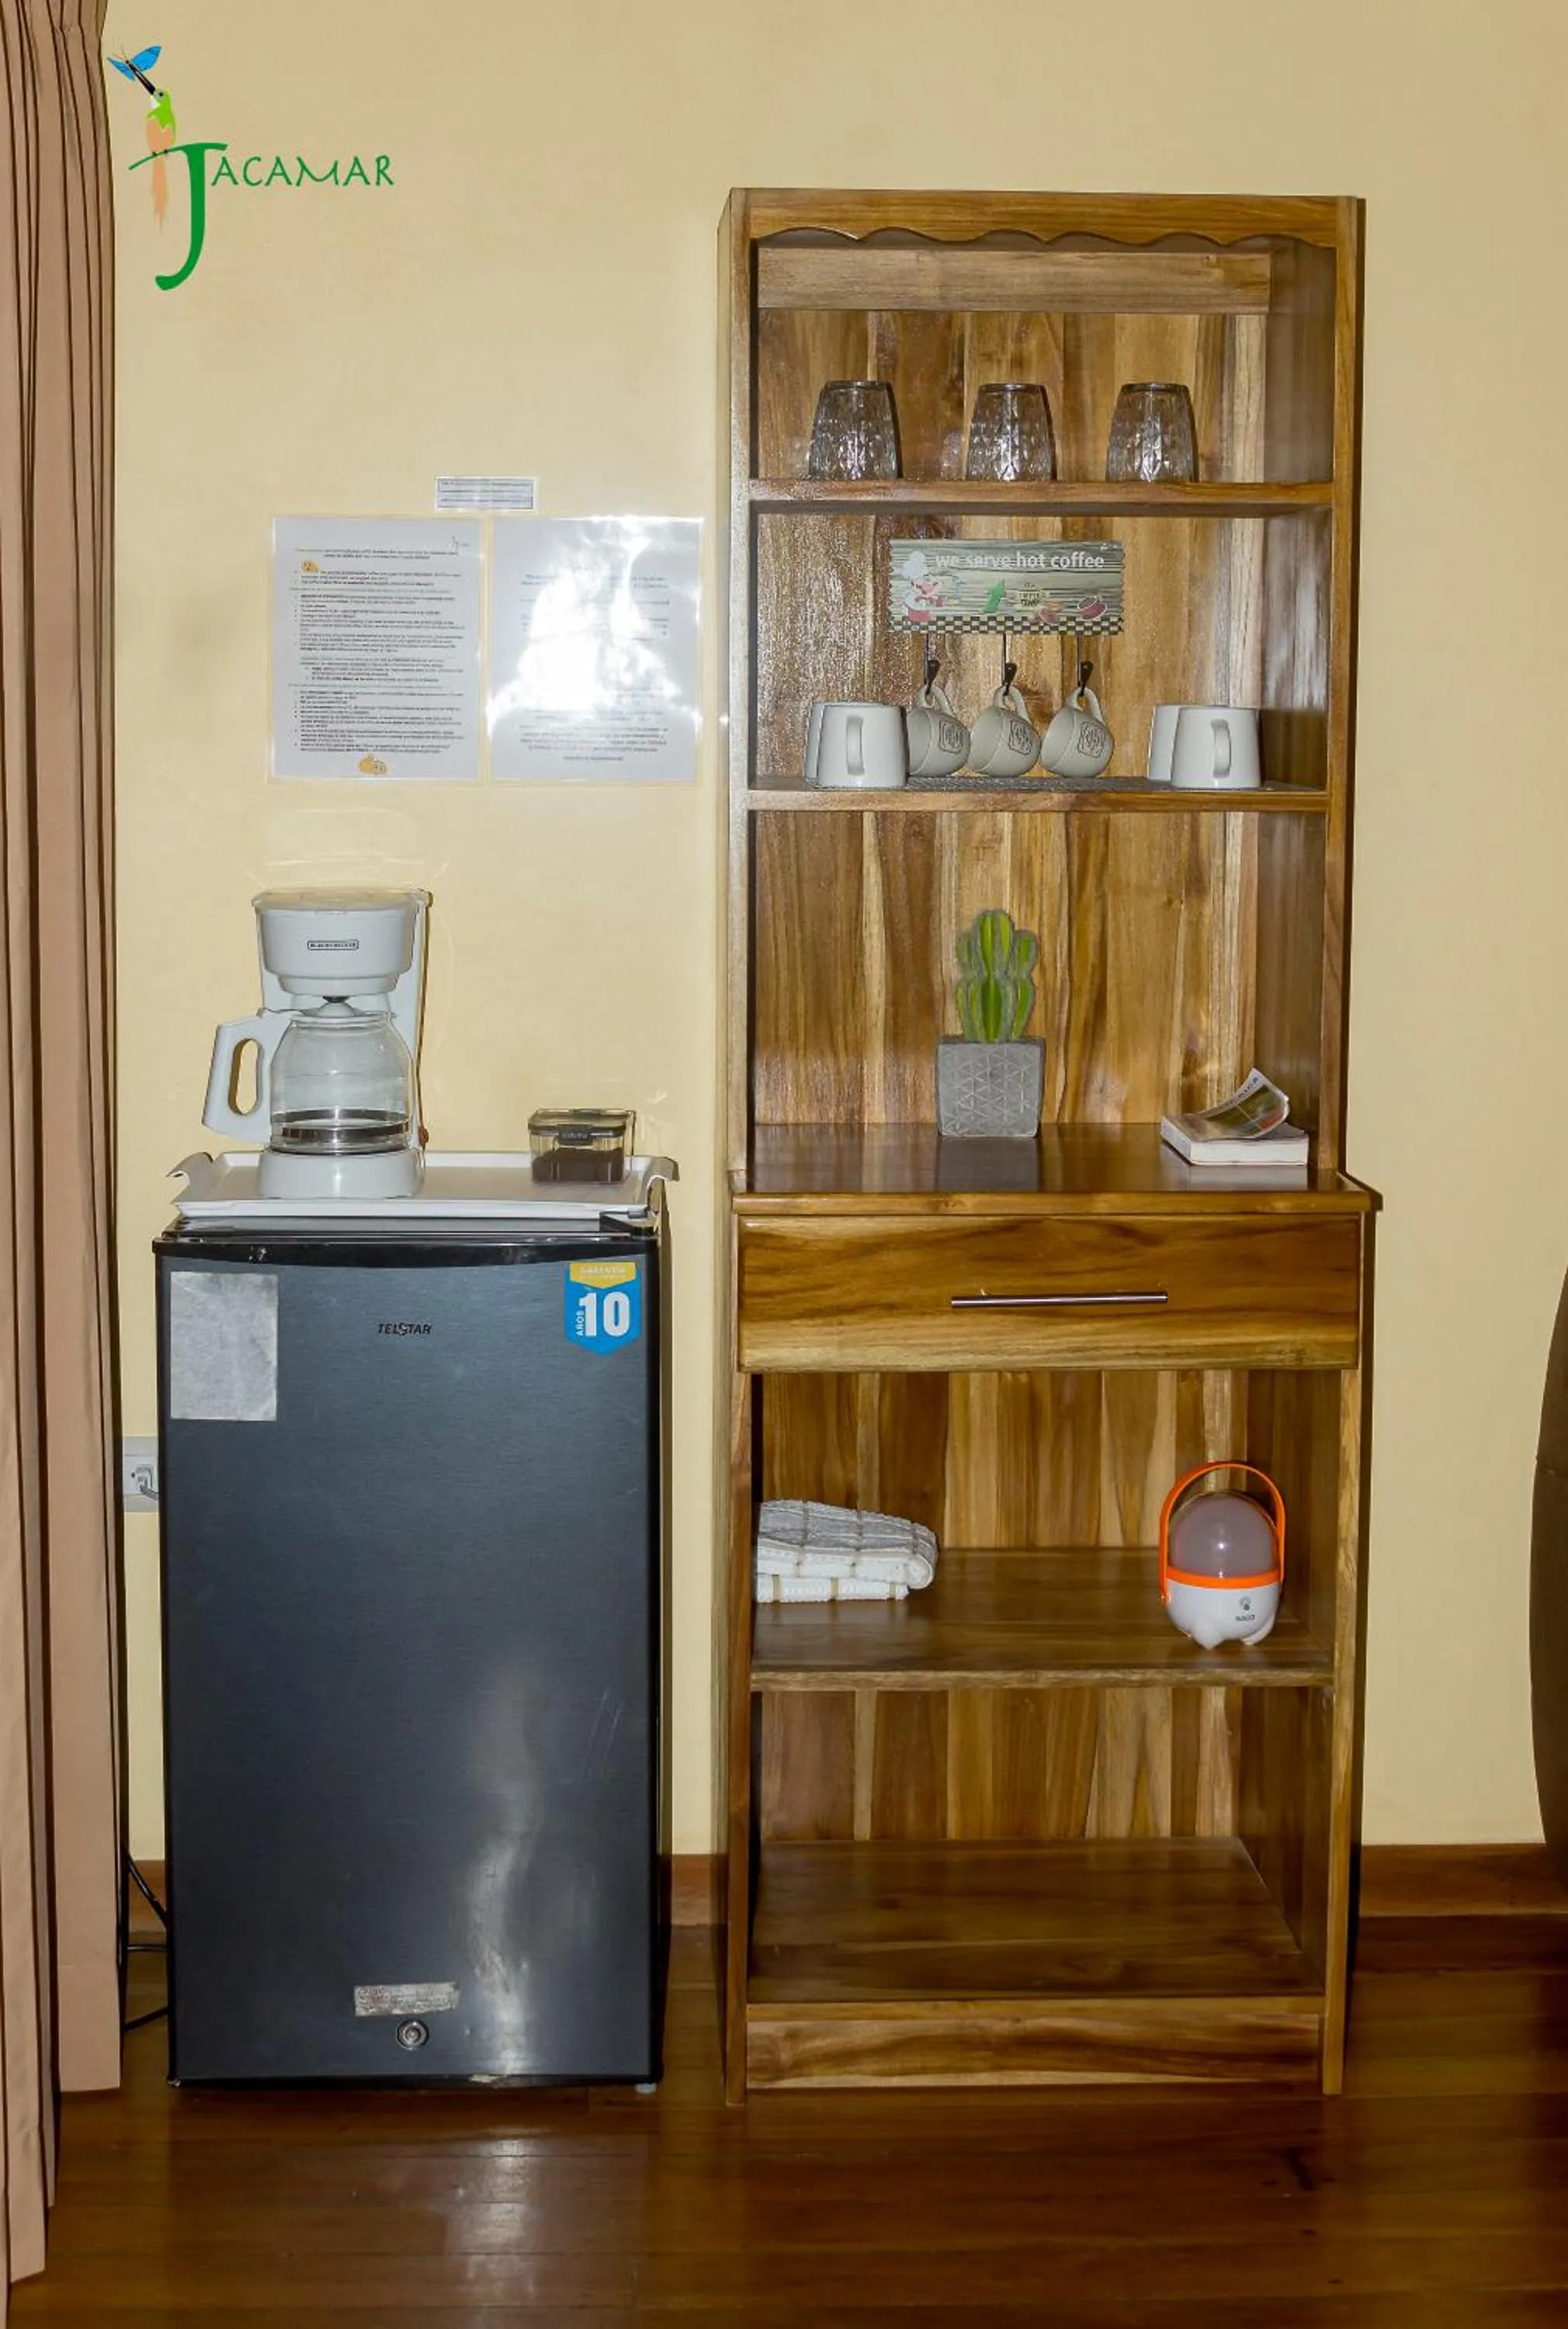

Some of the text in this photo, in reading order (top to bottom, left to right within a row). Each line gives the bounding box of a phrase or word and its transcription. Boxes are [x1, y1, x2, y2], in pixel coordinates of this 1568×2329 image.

[1016, 550, 1045, 567] hot
[1051, 551, 1105, 567] coffee
[579, 1291, 630, 1337] 10
[378, 1322, 432, 1335] TELSTAR
